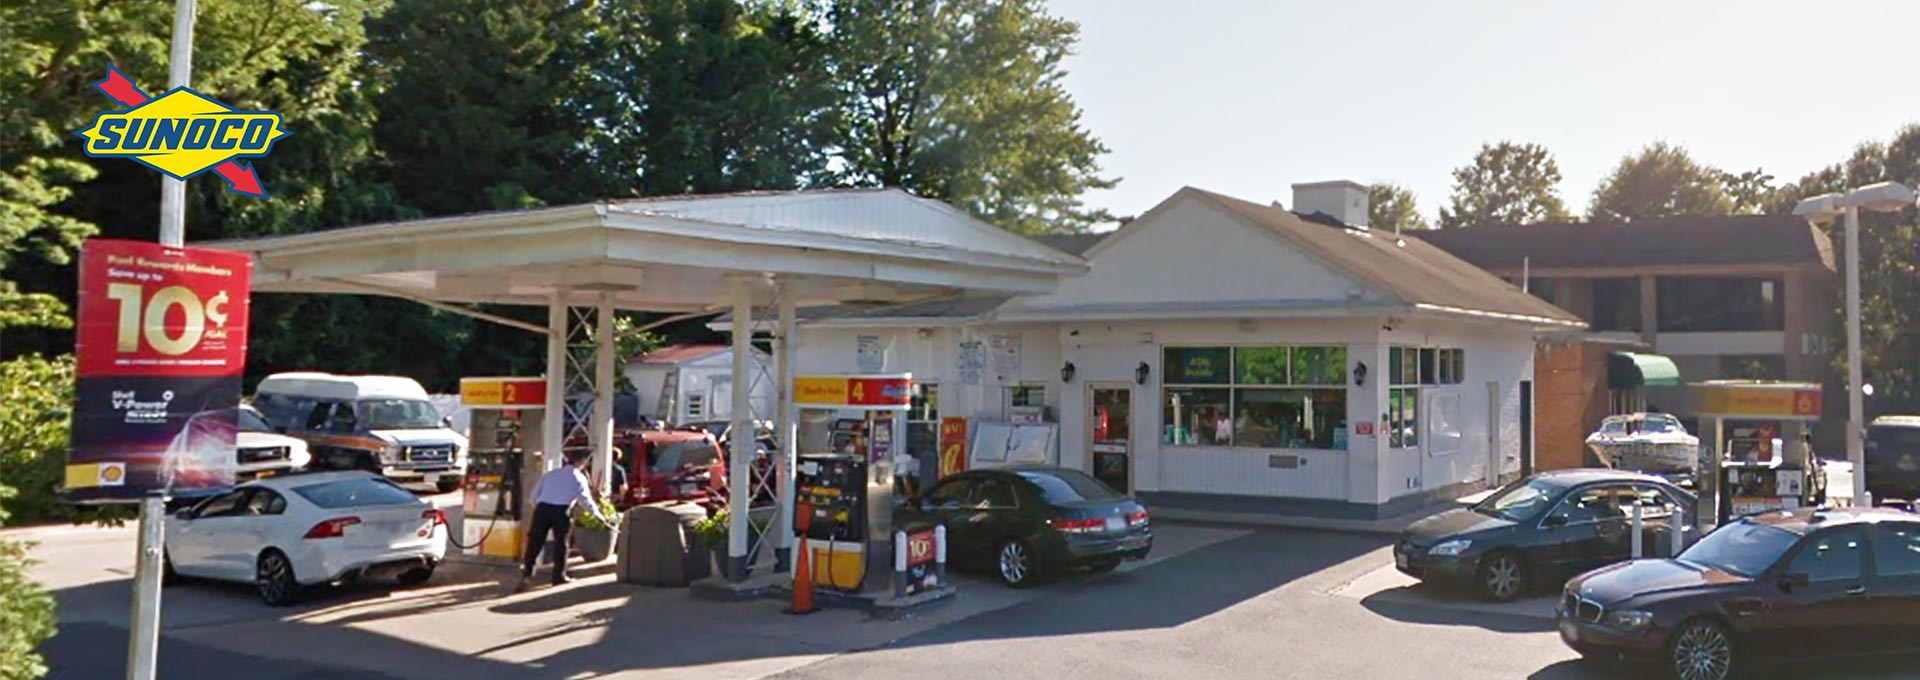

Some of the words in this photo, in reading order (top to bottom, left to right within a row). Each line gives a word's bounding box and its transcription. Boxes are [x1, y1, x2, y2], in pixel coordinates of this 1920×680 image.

[107, 268, 134, 279] Save
[137, 271, 150, 281] up
[152, 272, 163, 281] to
[186, 263, 232, 277] Members
[112, 390, 135, 400] Shell
[506, 384, 516, 402] 2
[852, 381, 864, 401] 4
[112, 399, 169, 410] V-Power
[1799, 393, 1812, 412] 6
